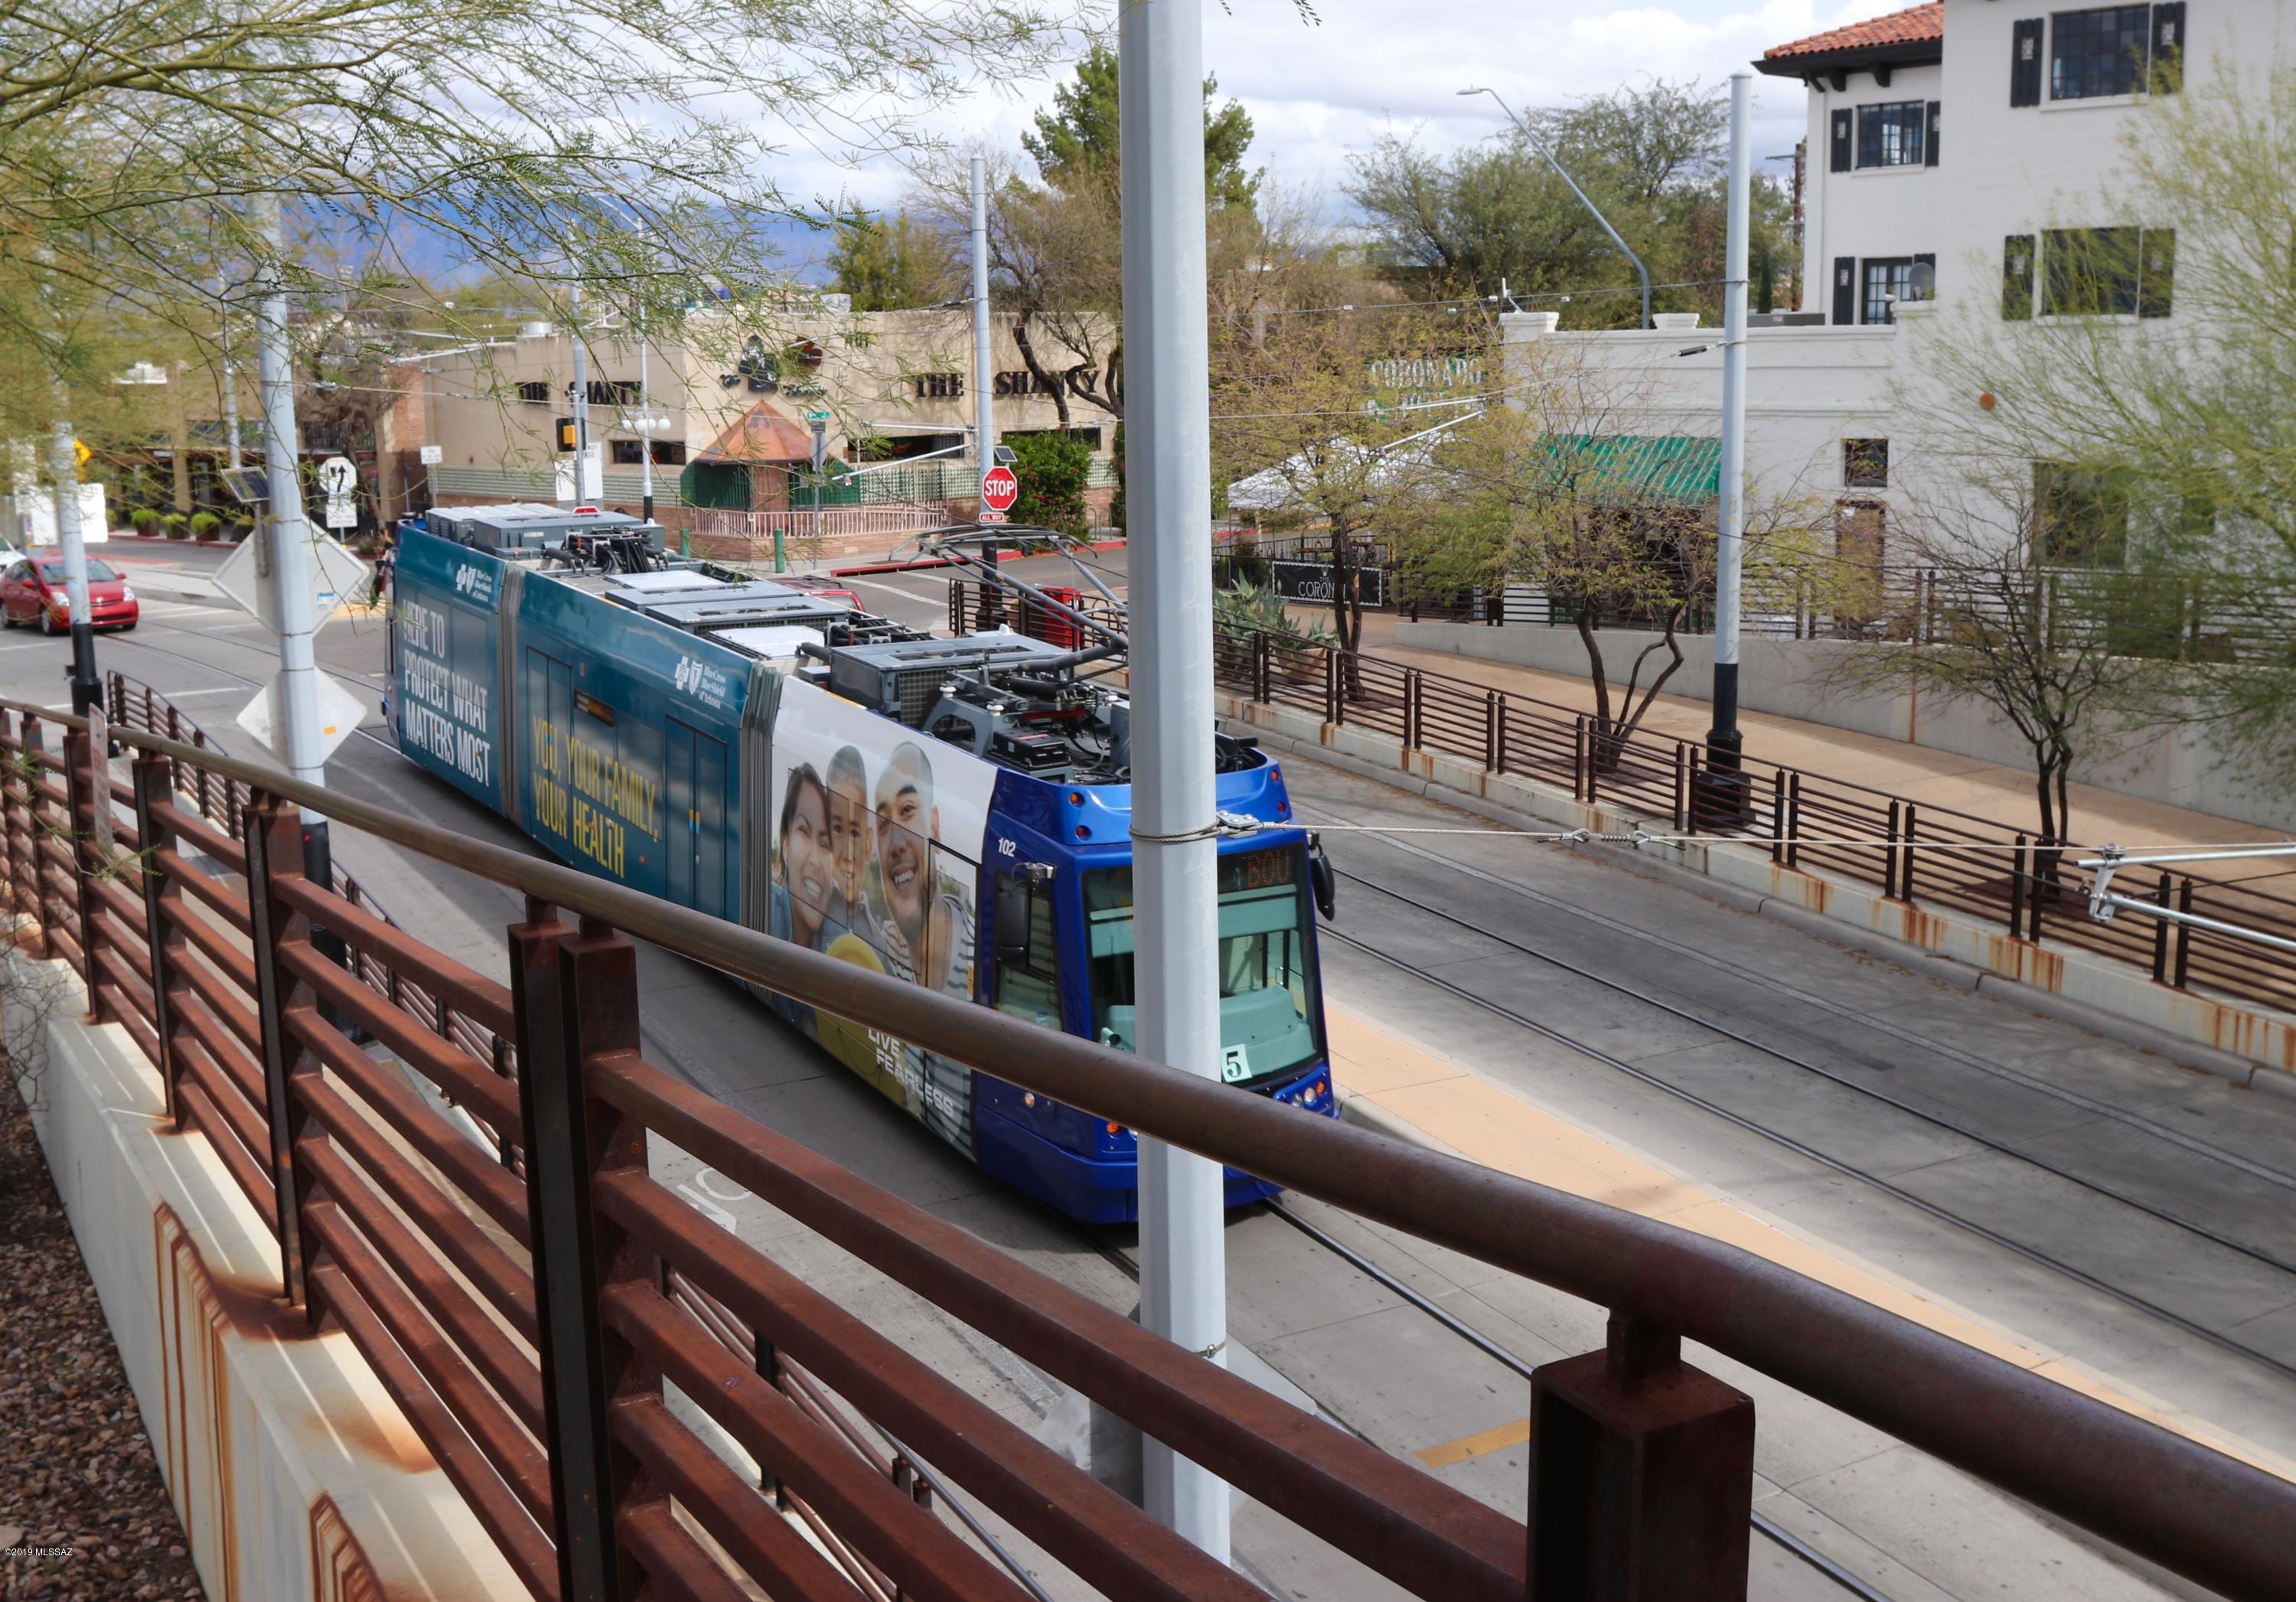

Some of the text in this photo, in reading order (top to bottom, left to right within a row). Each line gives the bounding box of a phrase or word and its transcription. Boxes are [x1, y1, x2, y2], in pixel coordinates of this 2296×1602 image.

[916, 372, 964, 397] THE
[984, 479, 1015, 497] STOP
[403, 599, 445, 658] HERE TO
[405, 649, 488, 733] PROTECT WHAT
[406, 698, 491, 788] MATTERS MOST
[566, 732, 600, 802] YOUR
[604, 755, 659, 843] FAMILY,
[533, 772, 625, 879] YOUR HEALTH
[998, 837, 1016, 857] 102
[869, 1029, 900, 1059] LIVE
[1226, 1050, 1242, 1078] 5
[876, 1046, 954, 1118] FEARLESS
